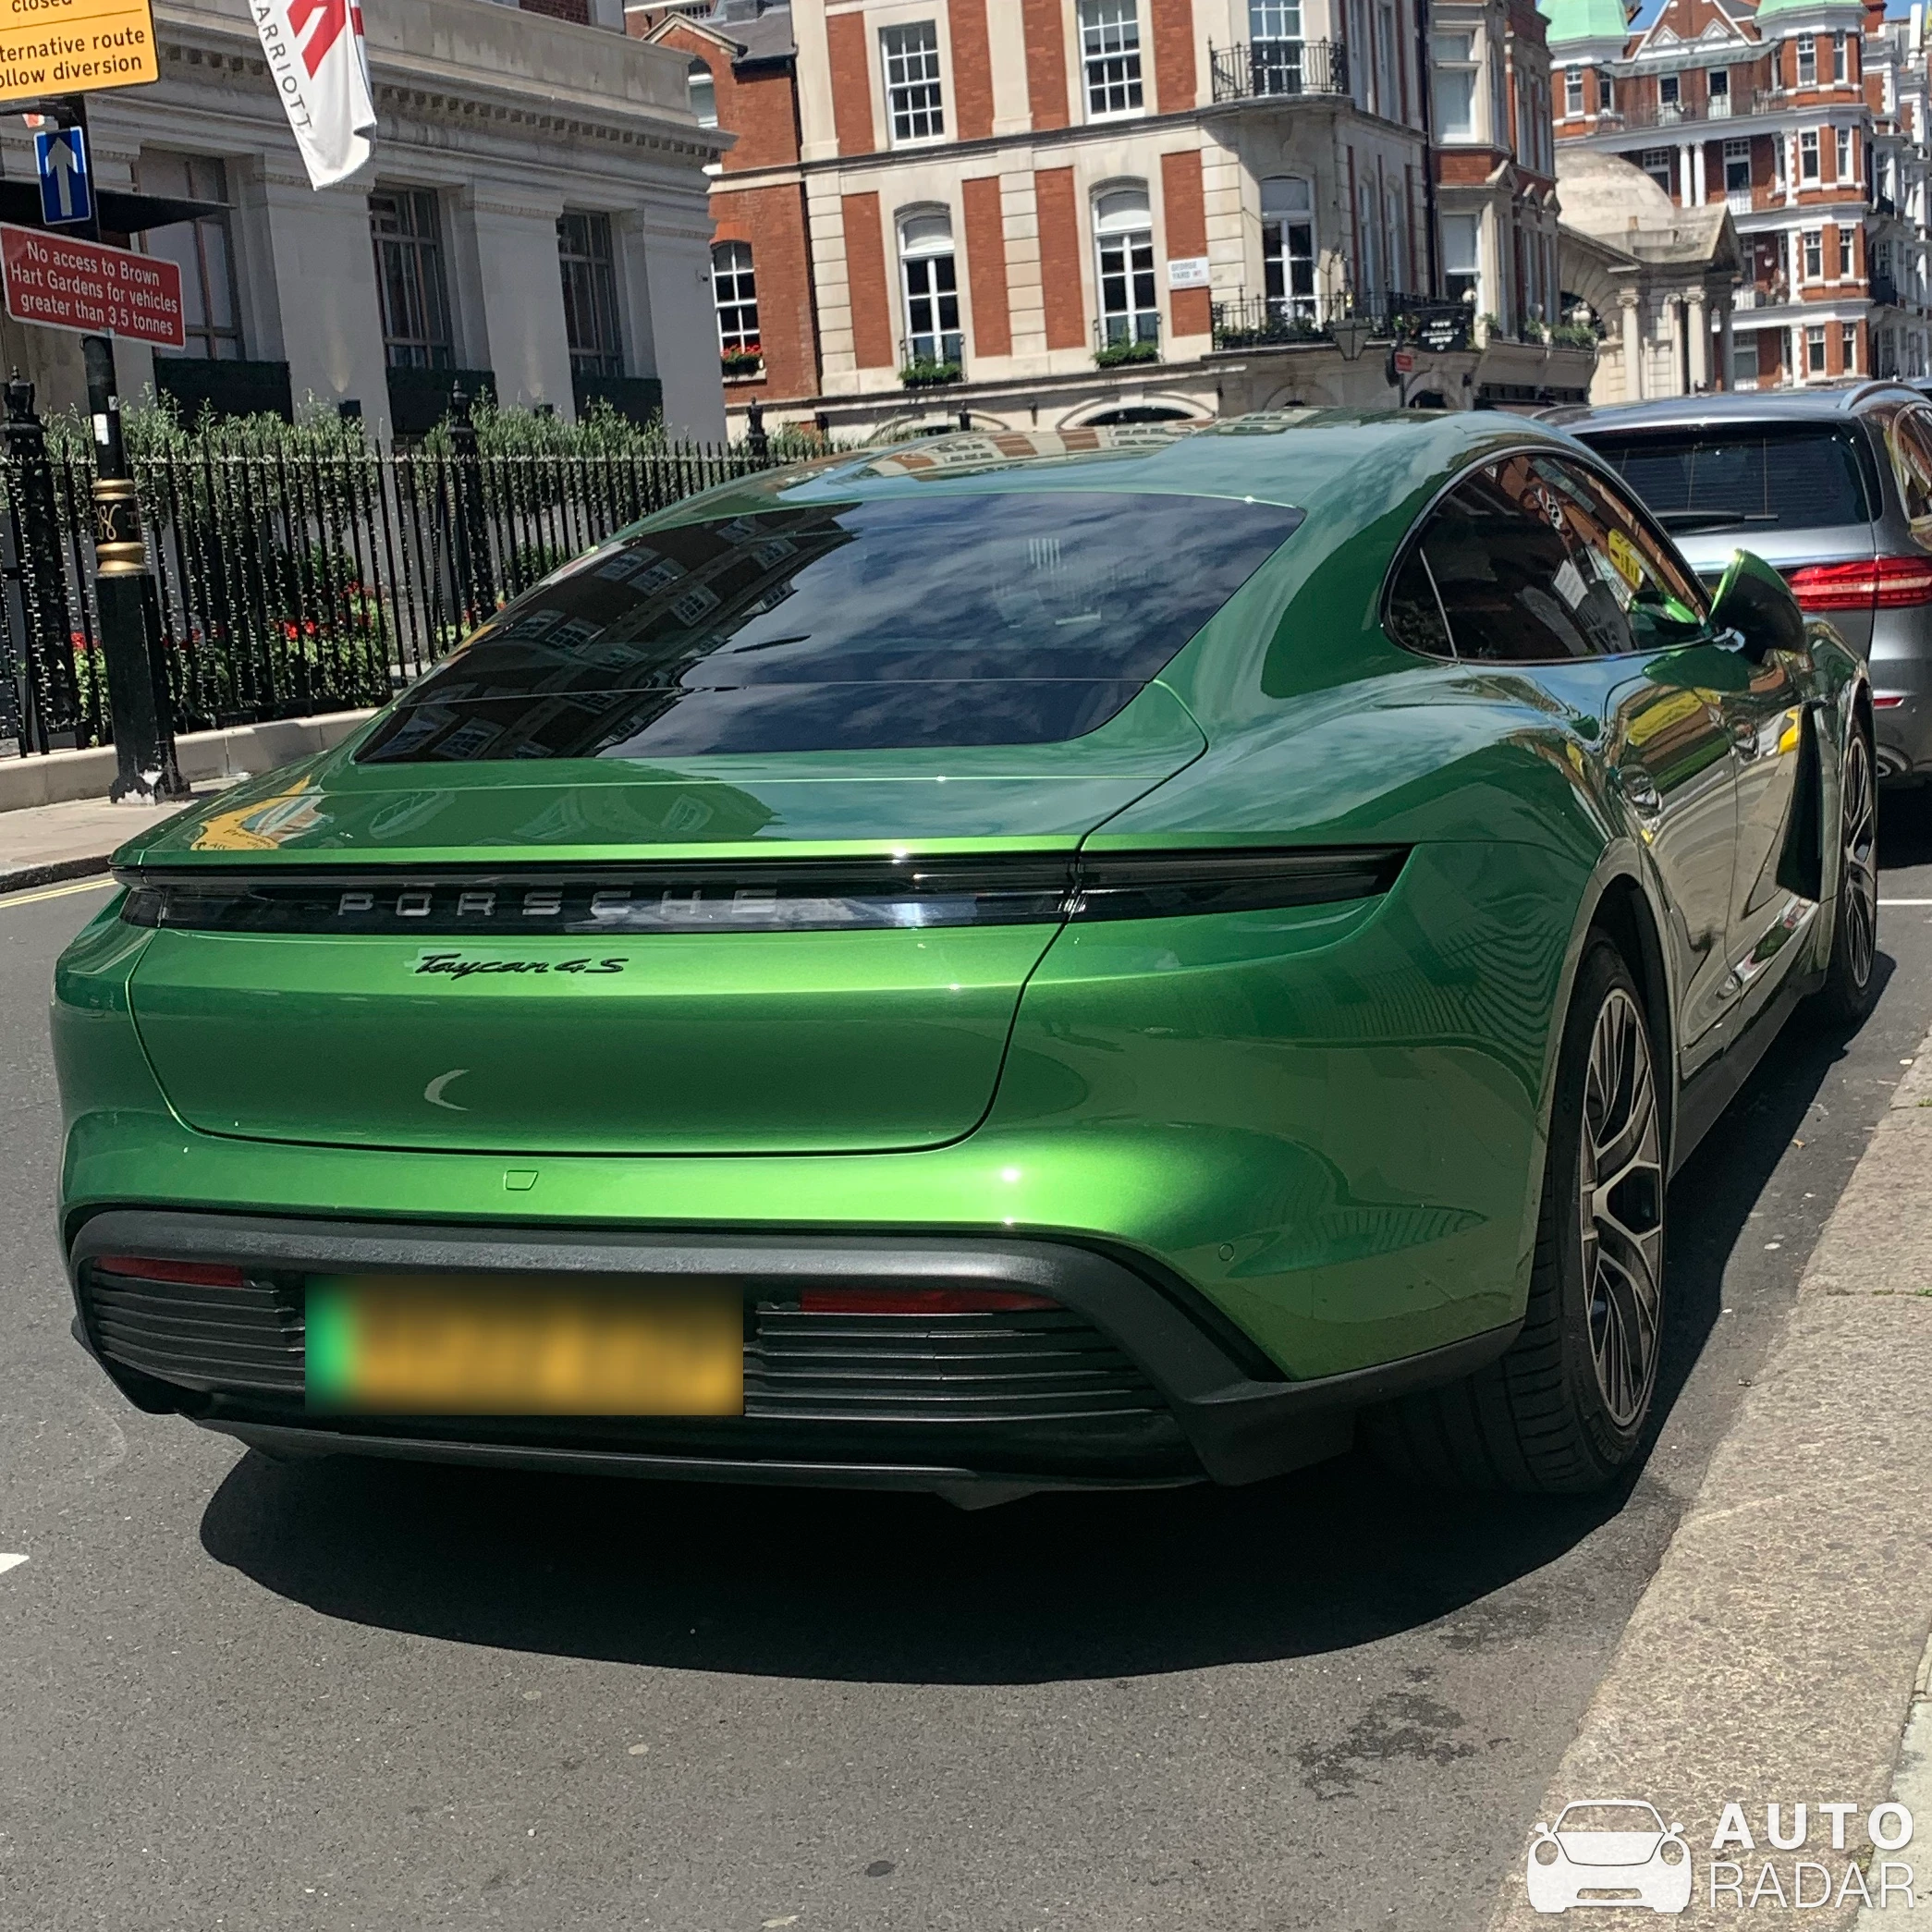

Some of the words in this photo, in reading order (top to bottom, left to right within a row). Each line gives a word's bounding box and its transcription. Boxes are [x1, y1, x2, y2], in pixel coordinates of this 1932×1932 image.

[92, 26, 145, 50] route
[53, 54, 142, 80] diversion
[254, 0, 312, 128] ARRIOTT
[27, 240, 48, 263] No
[53, 251, 98, 274] access
[101, 257, 116, 277] to
[120, 261, 160, 287] Brown
[10, 262, 44, 287] Hart
[47, 270, 104, 300] Gardens
[106, 281, 126, 303] for
[129, 289, 178, 314] vehicles
[20, 293, 70, 317] greater
[75, 300, 105, 323] than
[108, 305, 129, 328] 3.5
[132, 311, 174, 336] tonnes
[337, 889, 778, 917] PORSCHE
[415, 953, 549, 981] Taycan
[554, 958, 629, 973] 4S
